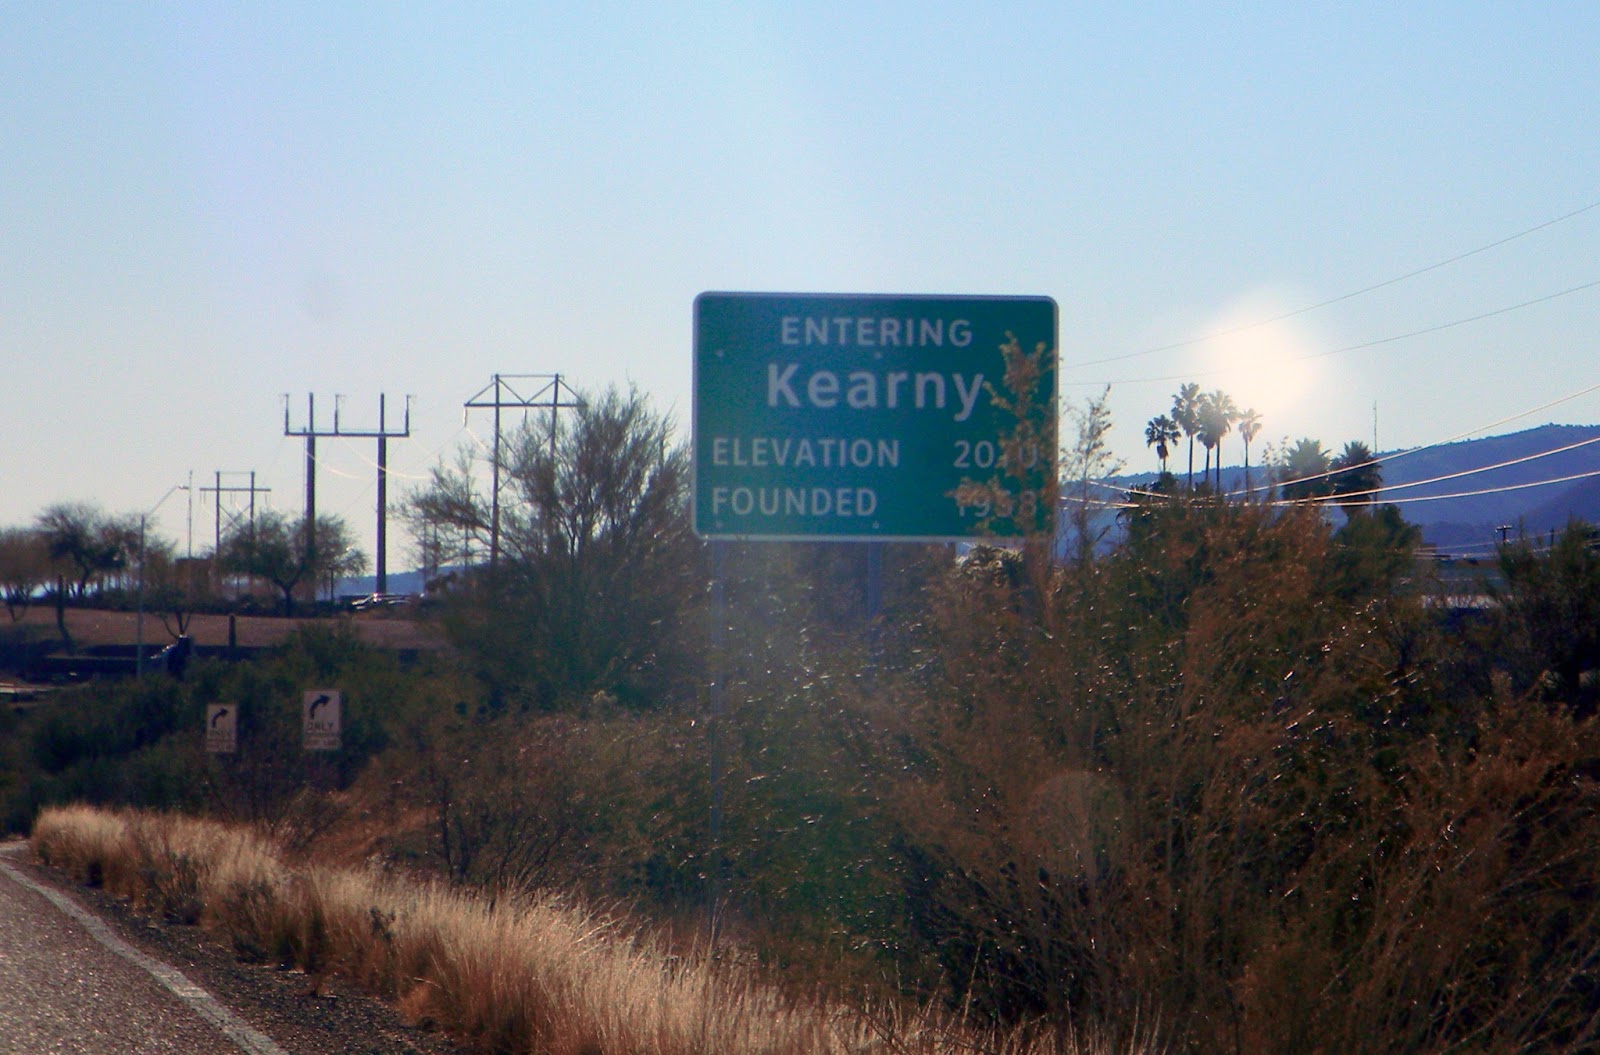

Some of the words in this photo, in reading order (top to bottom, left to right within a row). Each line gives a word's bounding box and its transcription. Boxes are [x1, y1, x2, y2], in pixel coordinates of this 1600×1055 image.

[781, 317, 973, 347] ENTERING
[767, 363, 984, 422] Kearny
[712, 438, 900, 468] ELEVATION
[953, 440, 1038, 468] 200
[712, 488, 877, 516] FOUNDED
